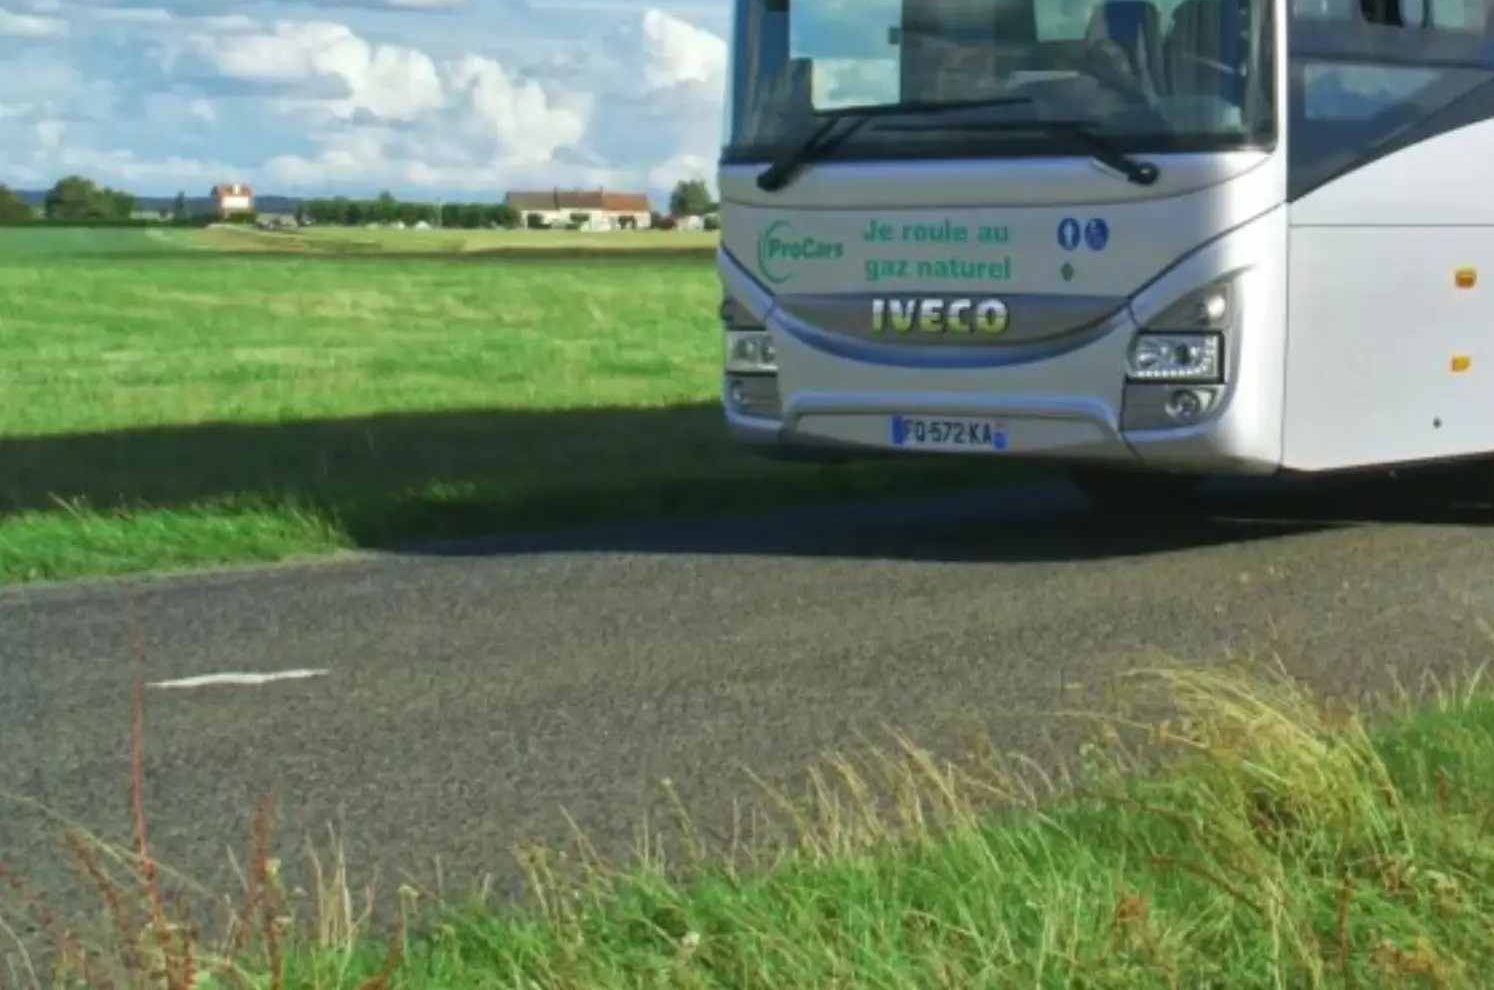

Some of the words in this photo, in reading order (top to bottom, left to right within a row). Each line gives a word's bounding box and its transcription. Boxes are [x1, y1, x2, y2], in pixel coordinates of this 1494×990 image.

[863, 219, 894, 242] Je
[902, 220, 968, 242] roule
[978, 224, 1009, 243] au
[767, 237, 844, 259] ProCars
[865, 259, 909, 281] gaz
[917, 257, 1011, 280] naturel
[872, 298, 1010, 337] IVECO
